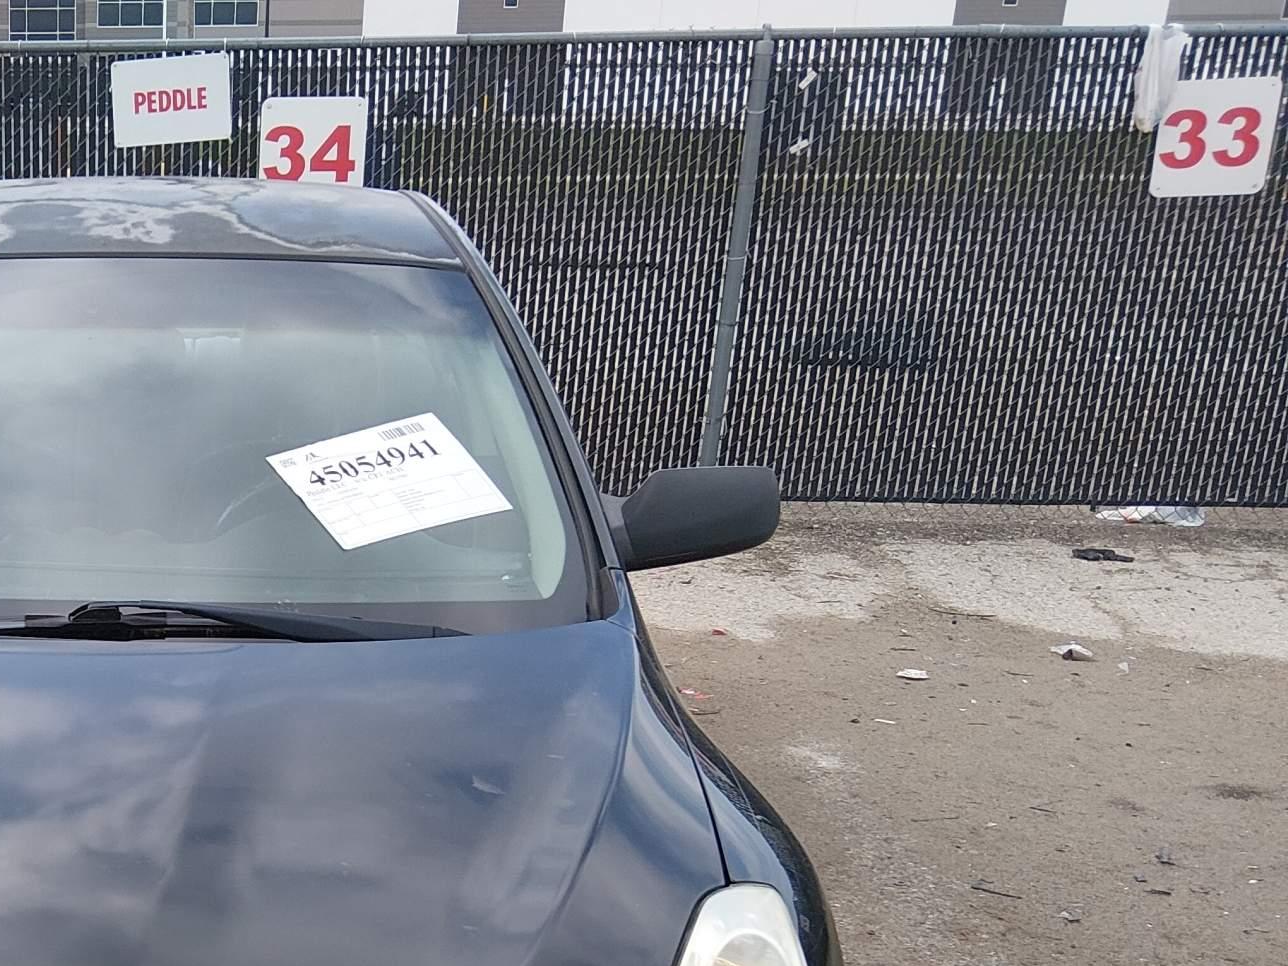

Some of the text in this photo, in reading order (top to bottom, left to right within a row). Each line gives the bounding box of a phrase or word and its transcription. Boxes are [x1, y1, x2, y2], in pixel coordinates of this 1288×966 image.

[133, 87, 208, 115] PEDDLE
[262, 125, 356, 182] 34
[1159, 107, 1262, 169] 33
[309, 439, 442, 487] 45054941
